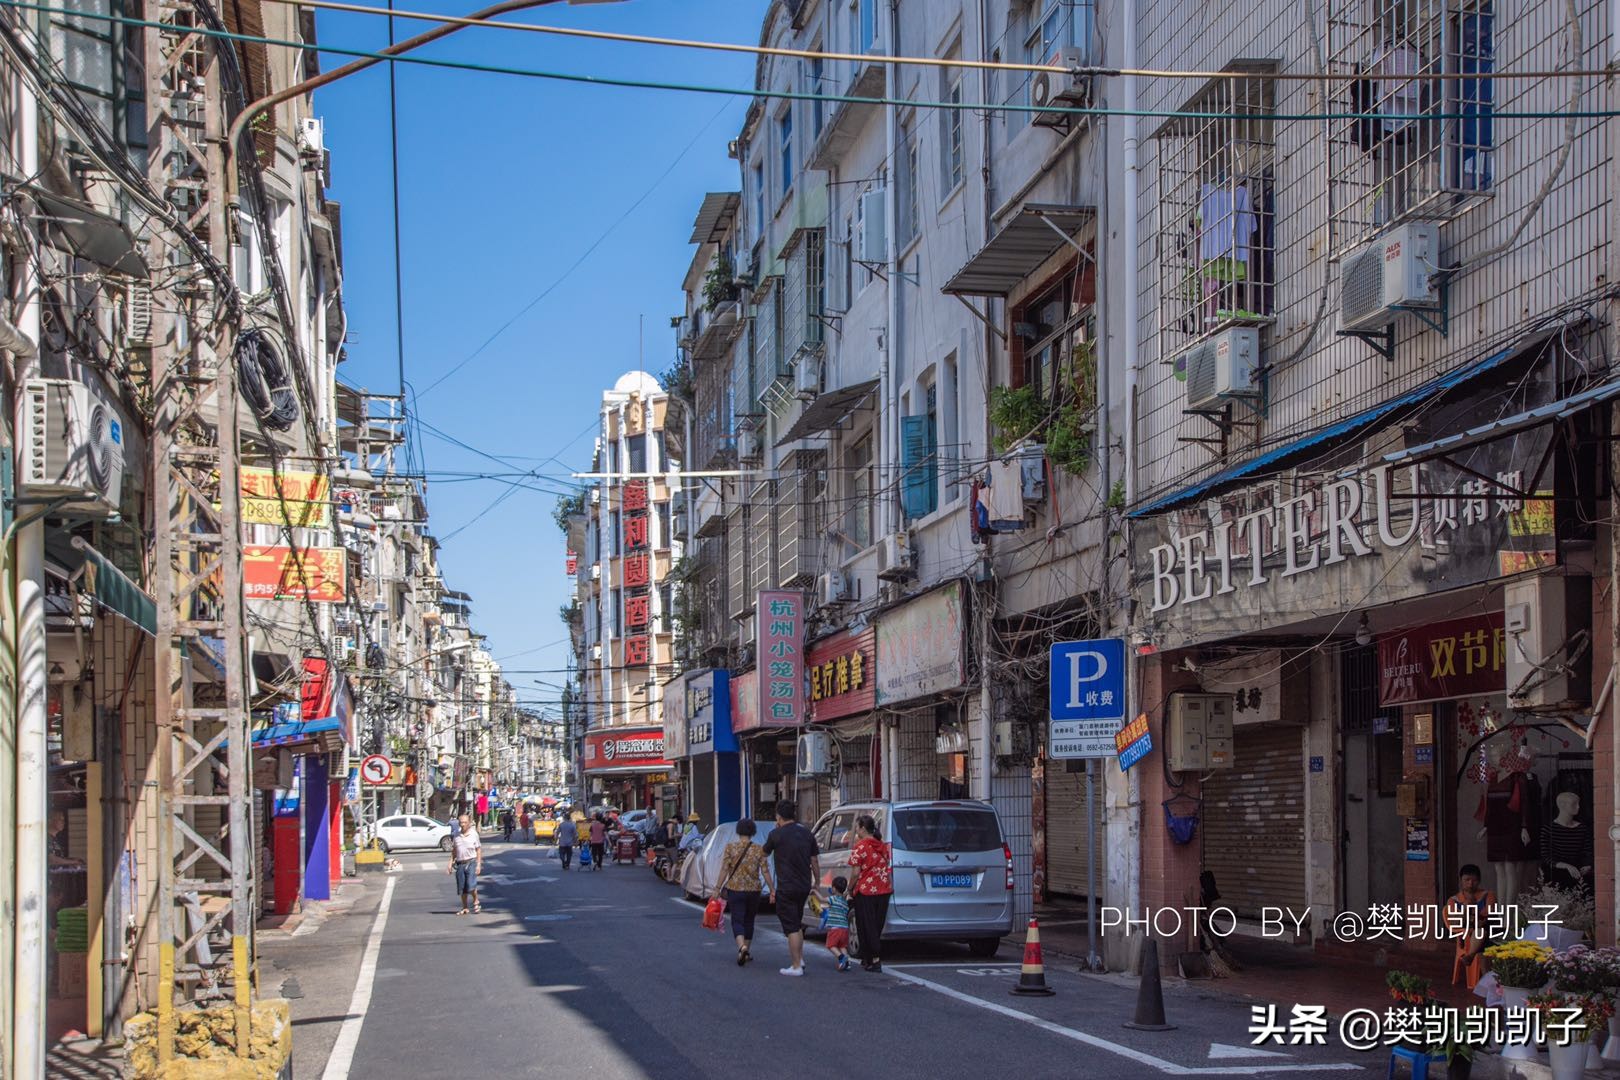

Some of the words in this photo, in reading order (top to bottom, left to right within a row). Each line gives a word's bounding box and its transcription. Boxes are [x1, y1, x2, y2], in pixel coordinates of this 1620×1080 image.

[1385, 241, 1401, 255] AUX
[1150, 463, 1421, 613] BEITERU
[320, 550, 343, 597] 发光字
[768, 600, 796, 720] 杭州小笼汤包
[811, 649, 863, 702] 足疗推拿
[1065, 651, 1108, 708] P
[1384, 663, 1422, 678] BEITERU
[1086, 690, 1114, 706] 收费
